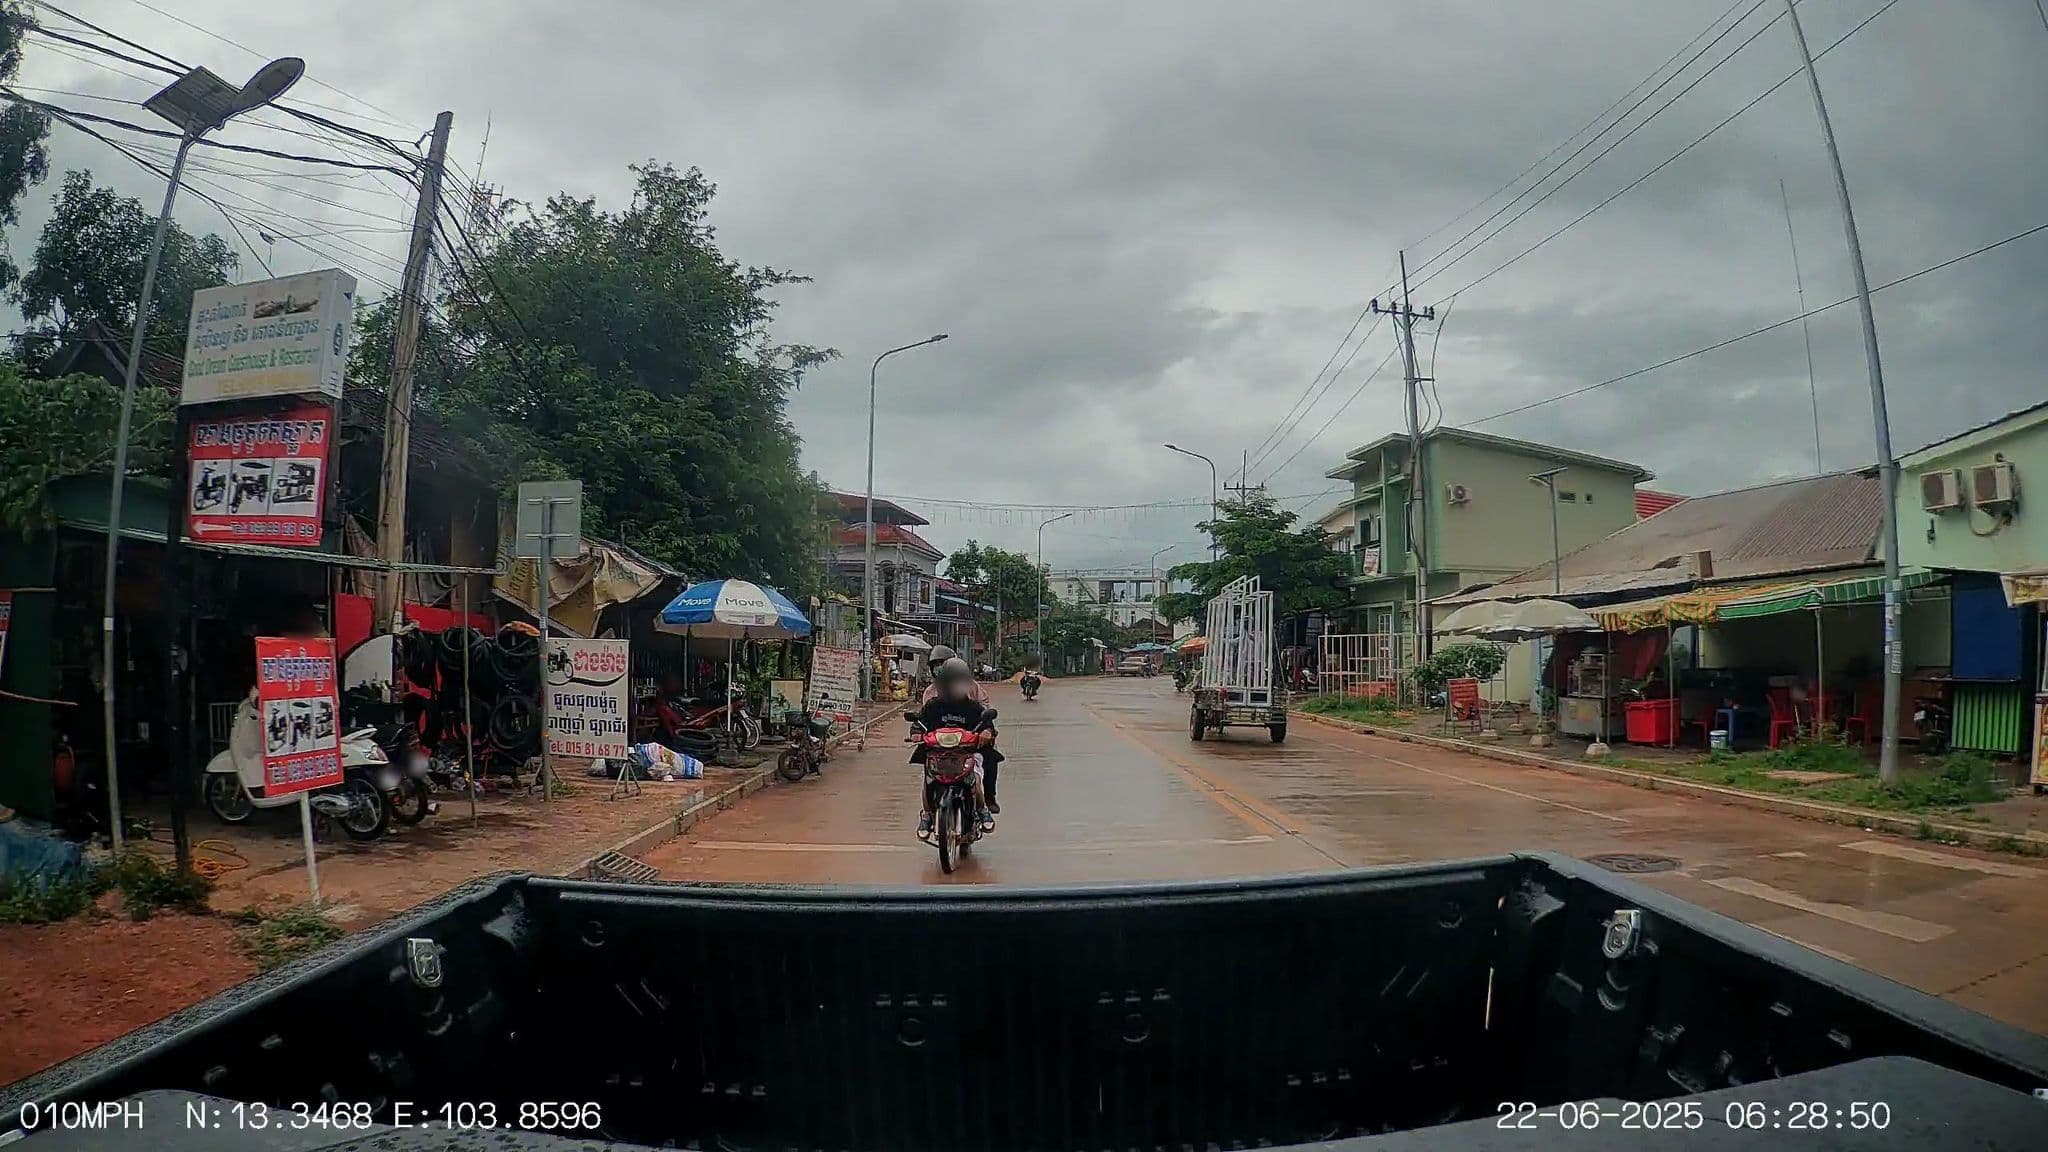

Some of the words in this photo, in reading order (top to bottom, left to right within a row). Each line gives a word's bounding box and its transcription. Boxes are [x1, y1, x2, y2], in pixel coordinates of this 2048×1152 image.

[678, 597, 712, 607] Move
[725, 597, 764, 608] Move
[565, 741, 582, 754] 015
[613, 744, 625, 757] 77
